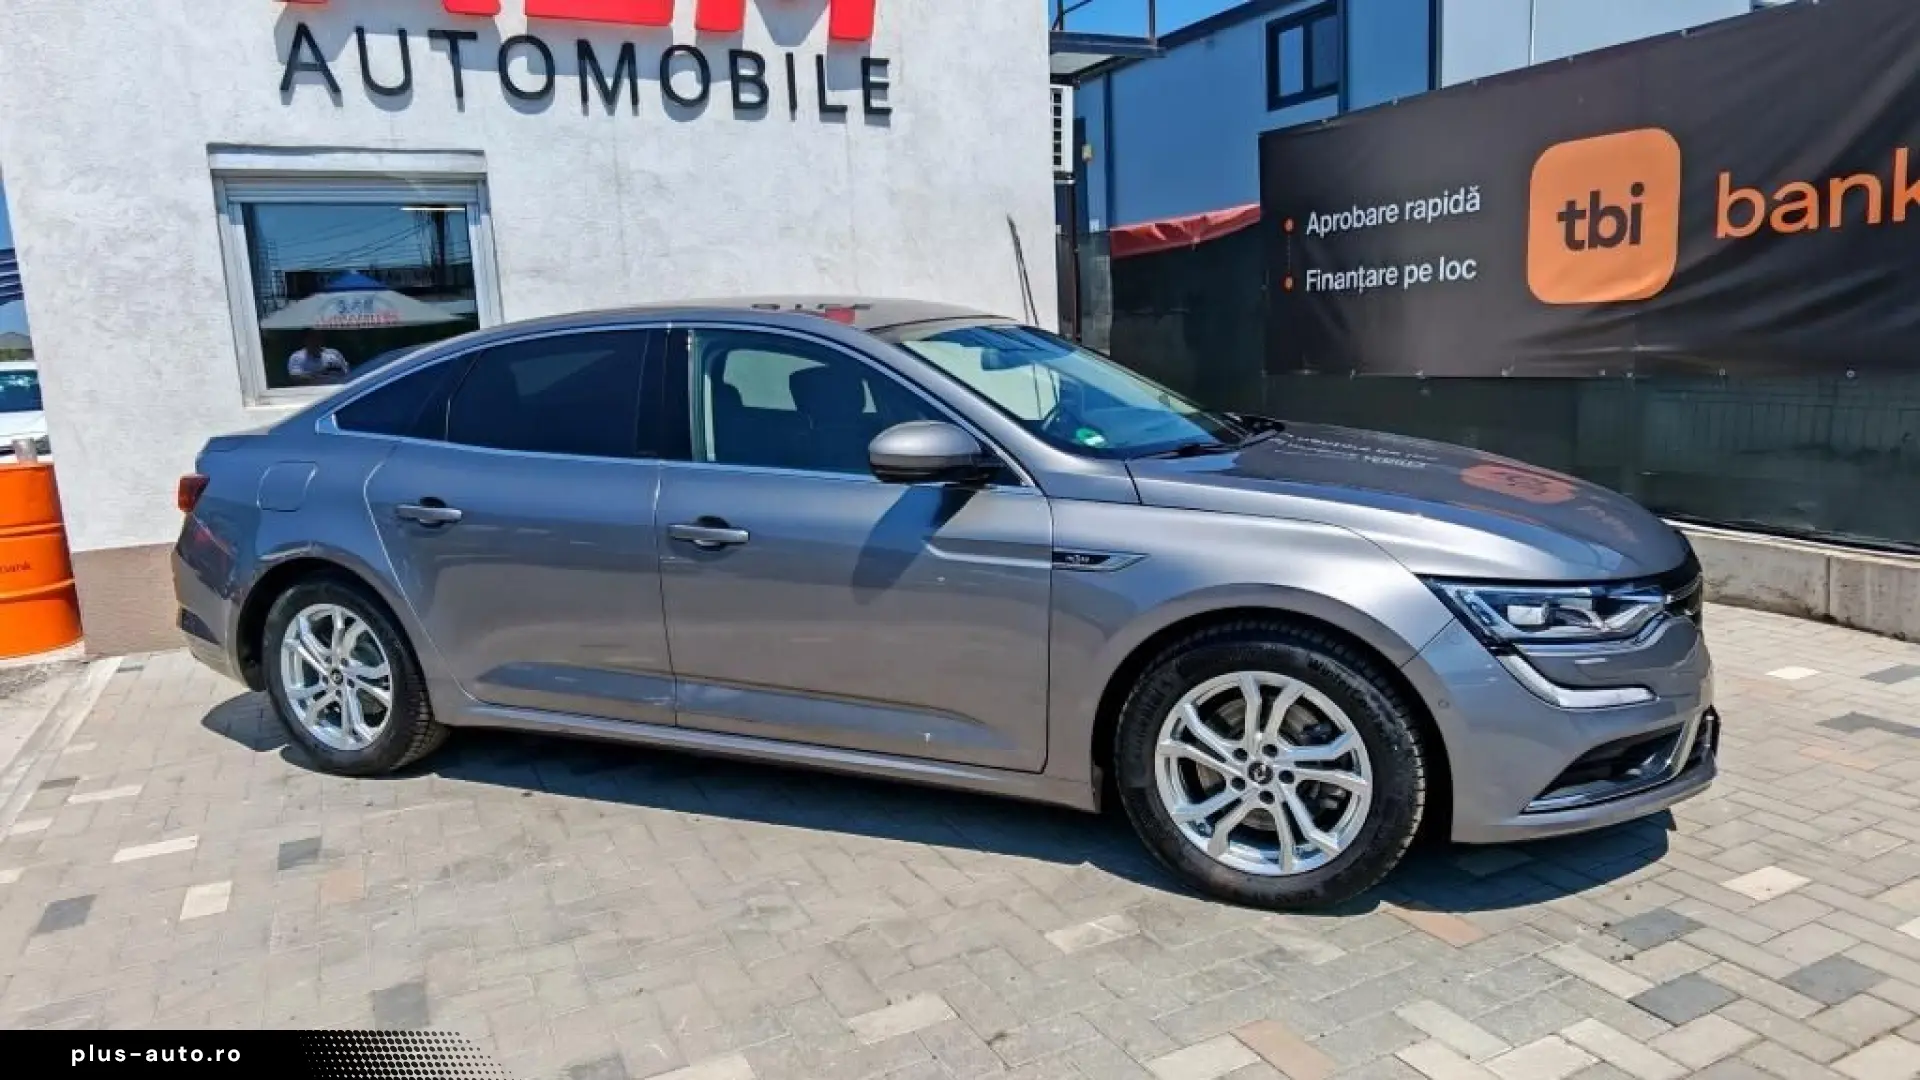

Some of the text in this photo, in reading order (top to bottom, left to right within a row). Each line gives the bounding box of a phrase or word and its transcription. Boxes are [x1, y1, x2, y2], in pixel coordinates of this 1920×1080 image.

[280, 22, 893, 118] AUTOMOBILE
[1306, 185, 1480, 238] Aprobare rapidă
[1557, 182, 1645, 252] tbi
[1306, 255, 1477, 294] Finanțare pe loc
